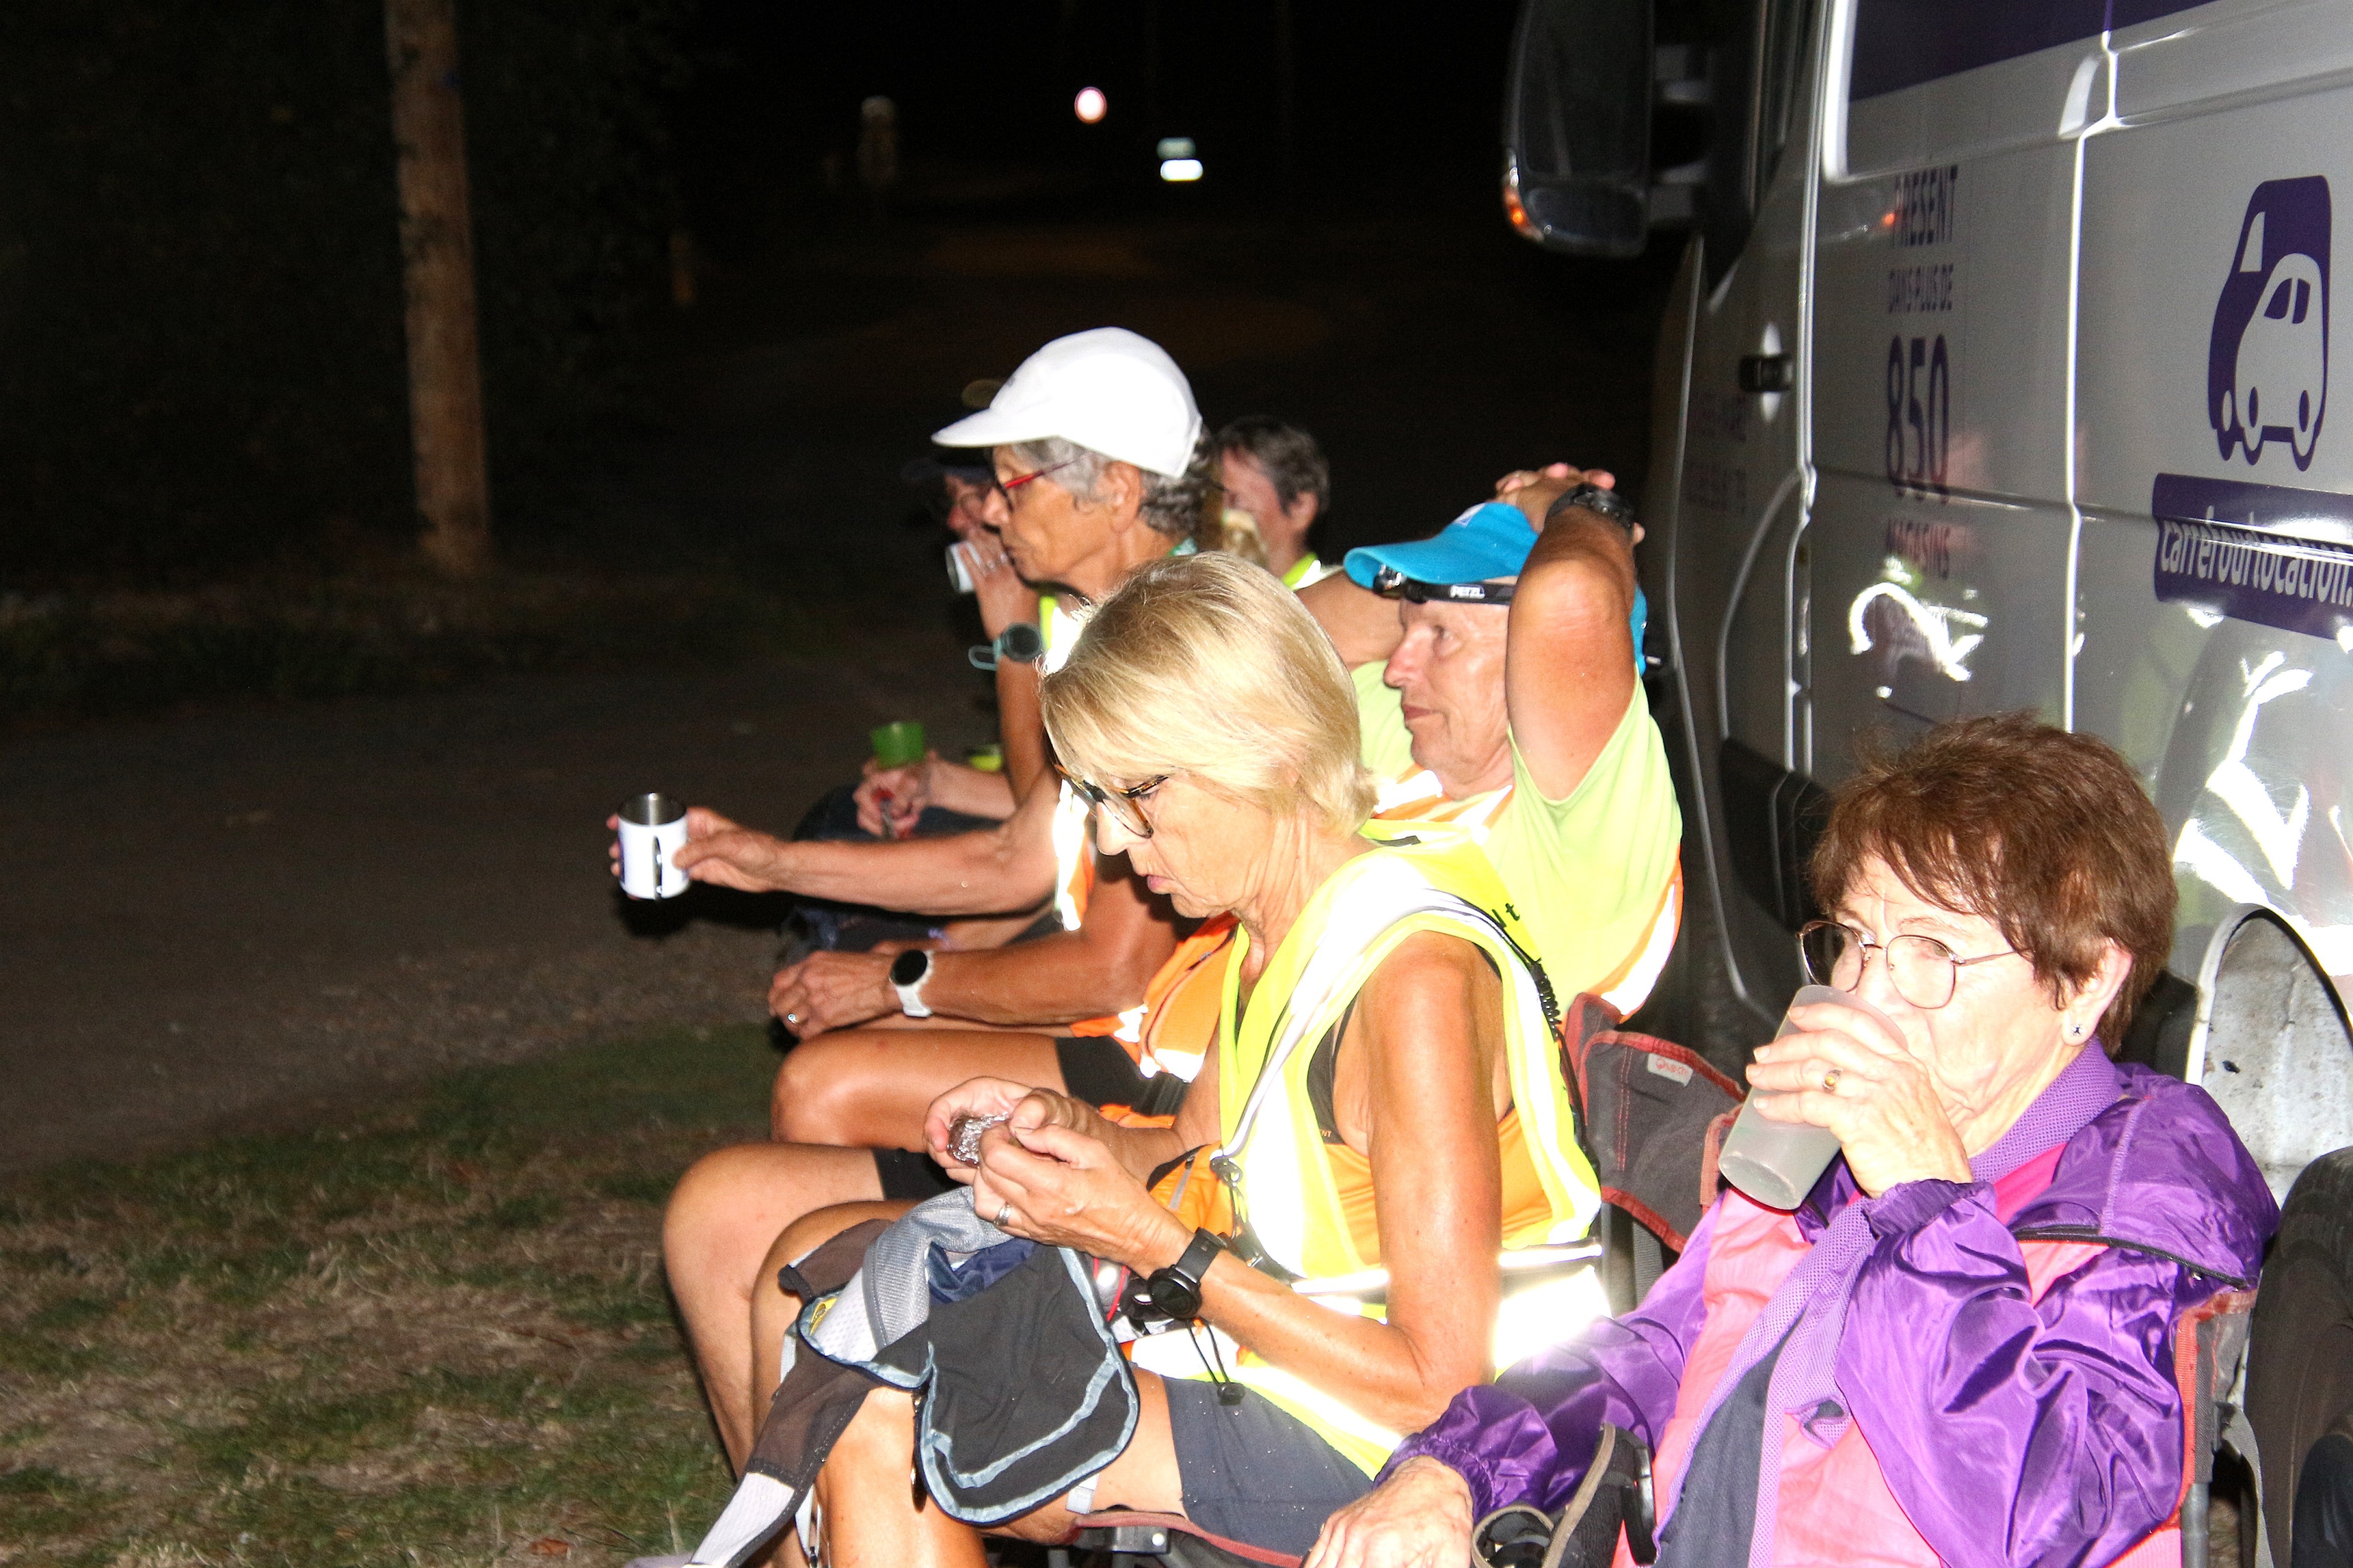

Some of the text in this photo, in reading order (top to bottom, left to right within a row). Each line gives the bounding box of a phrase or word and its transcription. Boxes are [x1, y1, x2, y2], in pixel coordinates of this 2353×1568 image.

[1888, 263, 1954, 313] DANS PLUS DE
[1885, 333, 1950, 504] 850
[1449, 585, 1486, 599] PETZL
